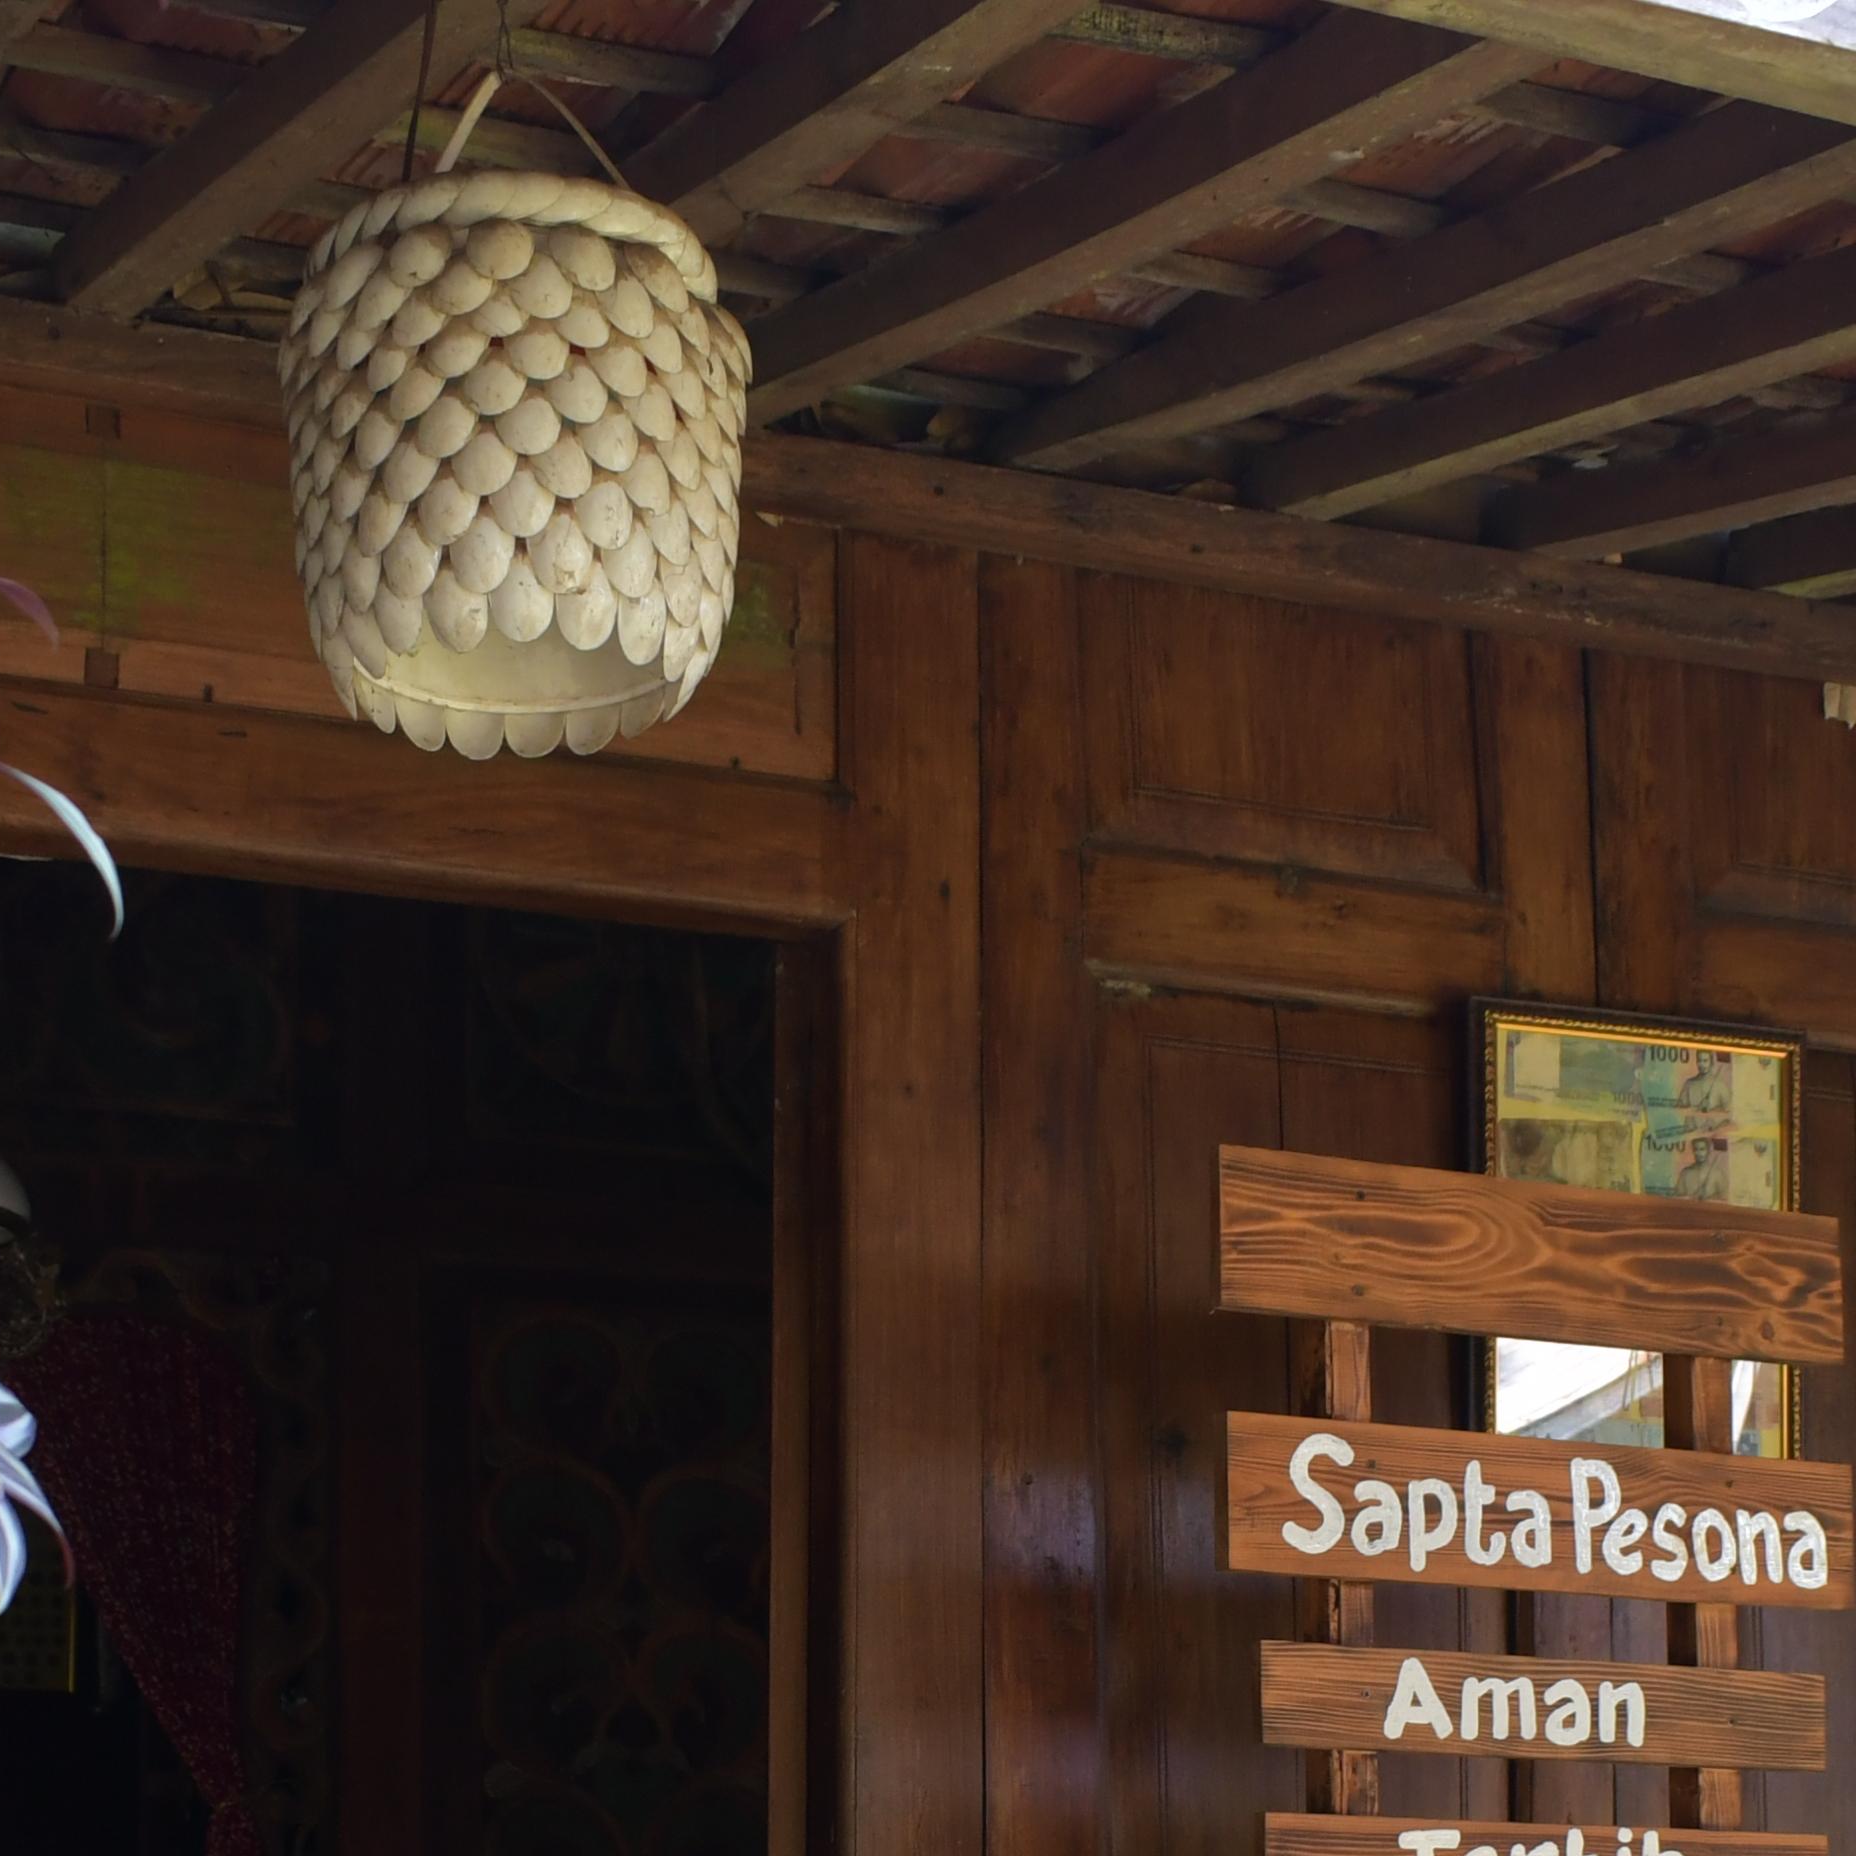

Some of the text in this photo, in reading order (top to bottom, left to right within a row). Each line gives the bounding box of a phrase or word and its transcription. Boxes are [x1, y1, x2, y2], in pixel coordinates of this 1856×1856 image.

[1649, 1046, 1690, 1064] 1000
[1282, 1433, 1828, 1590] Sapta Pesona
[1384, 1657, 1646, 1748] Aman
